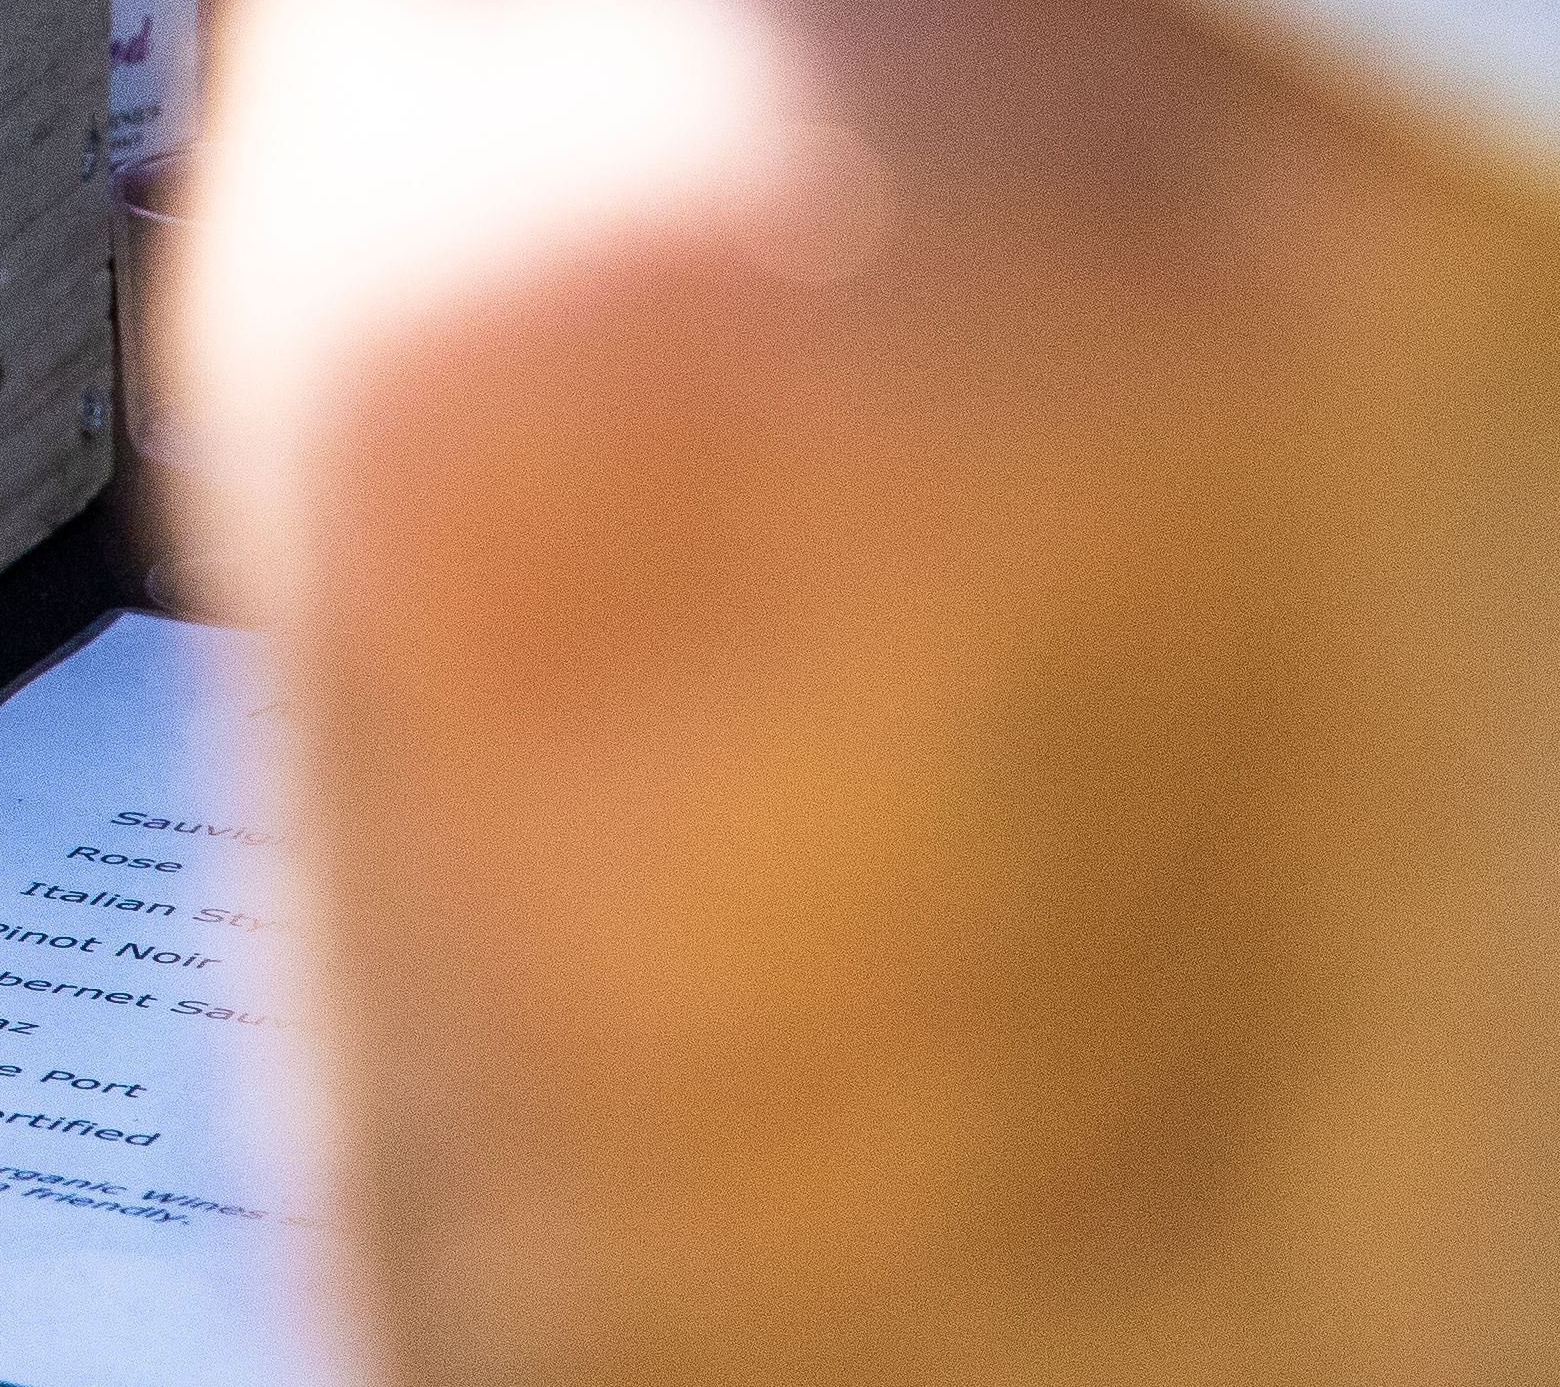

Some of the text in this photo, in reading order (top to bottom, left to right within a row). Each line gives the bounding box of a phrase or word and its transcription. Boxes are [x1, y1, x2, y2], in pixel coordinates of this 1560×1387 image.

[110, 810, 285, 849] Sauvig
[65, 845, 184, 874] Rose
[19, 881, 178, 918] Italian
[113, 940, 222, 970] Noir
[38, 1068, 149, 1100] Port
[21, 1186, 192, 1226] friendly.
[138, 1188, 271, 1221] Wines
